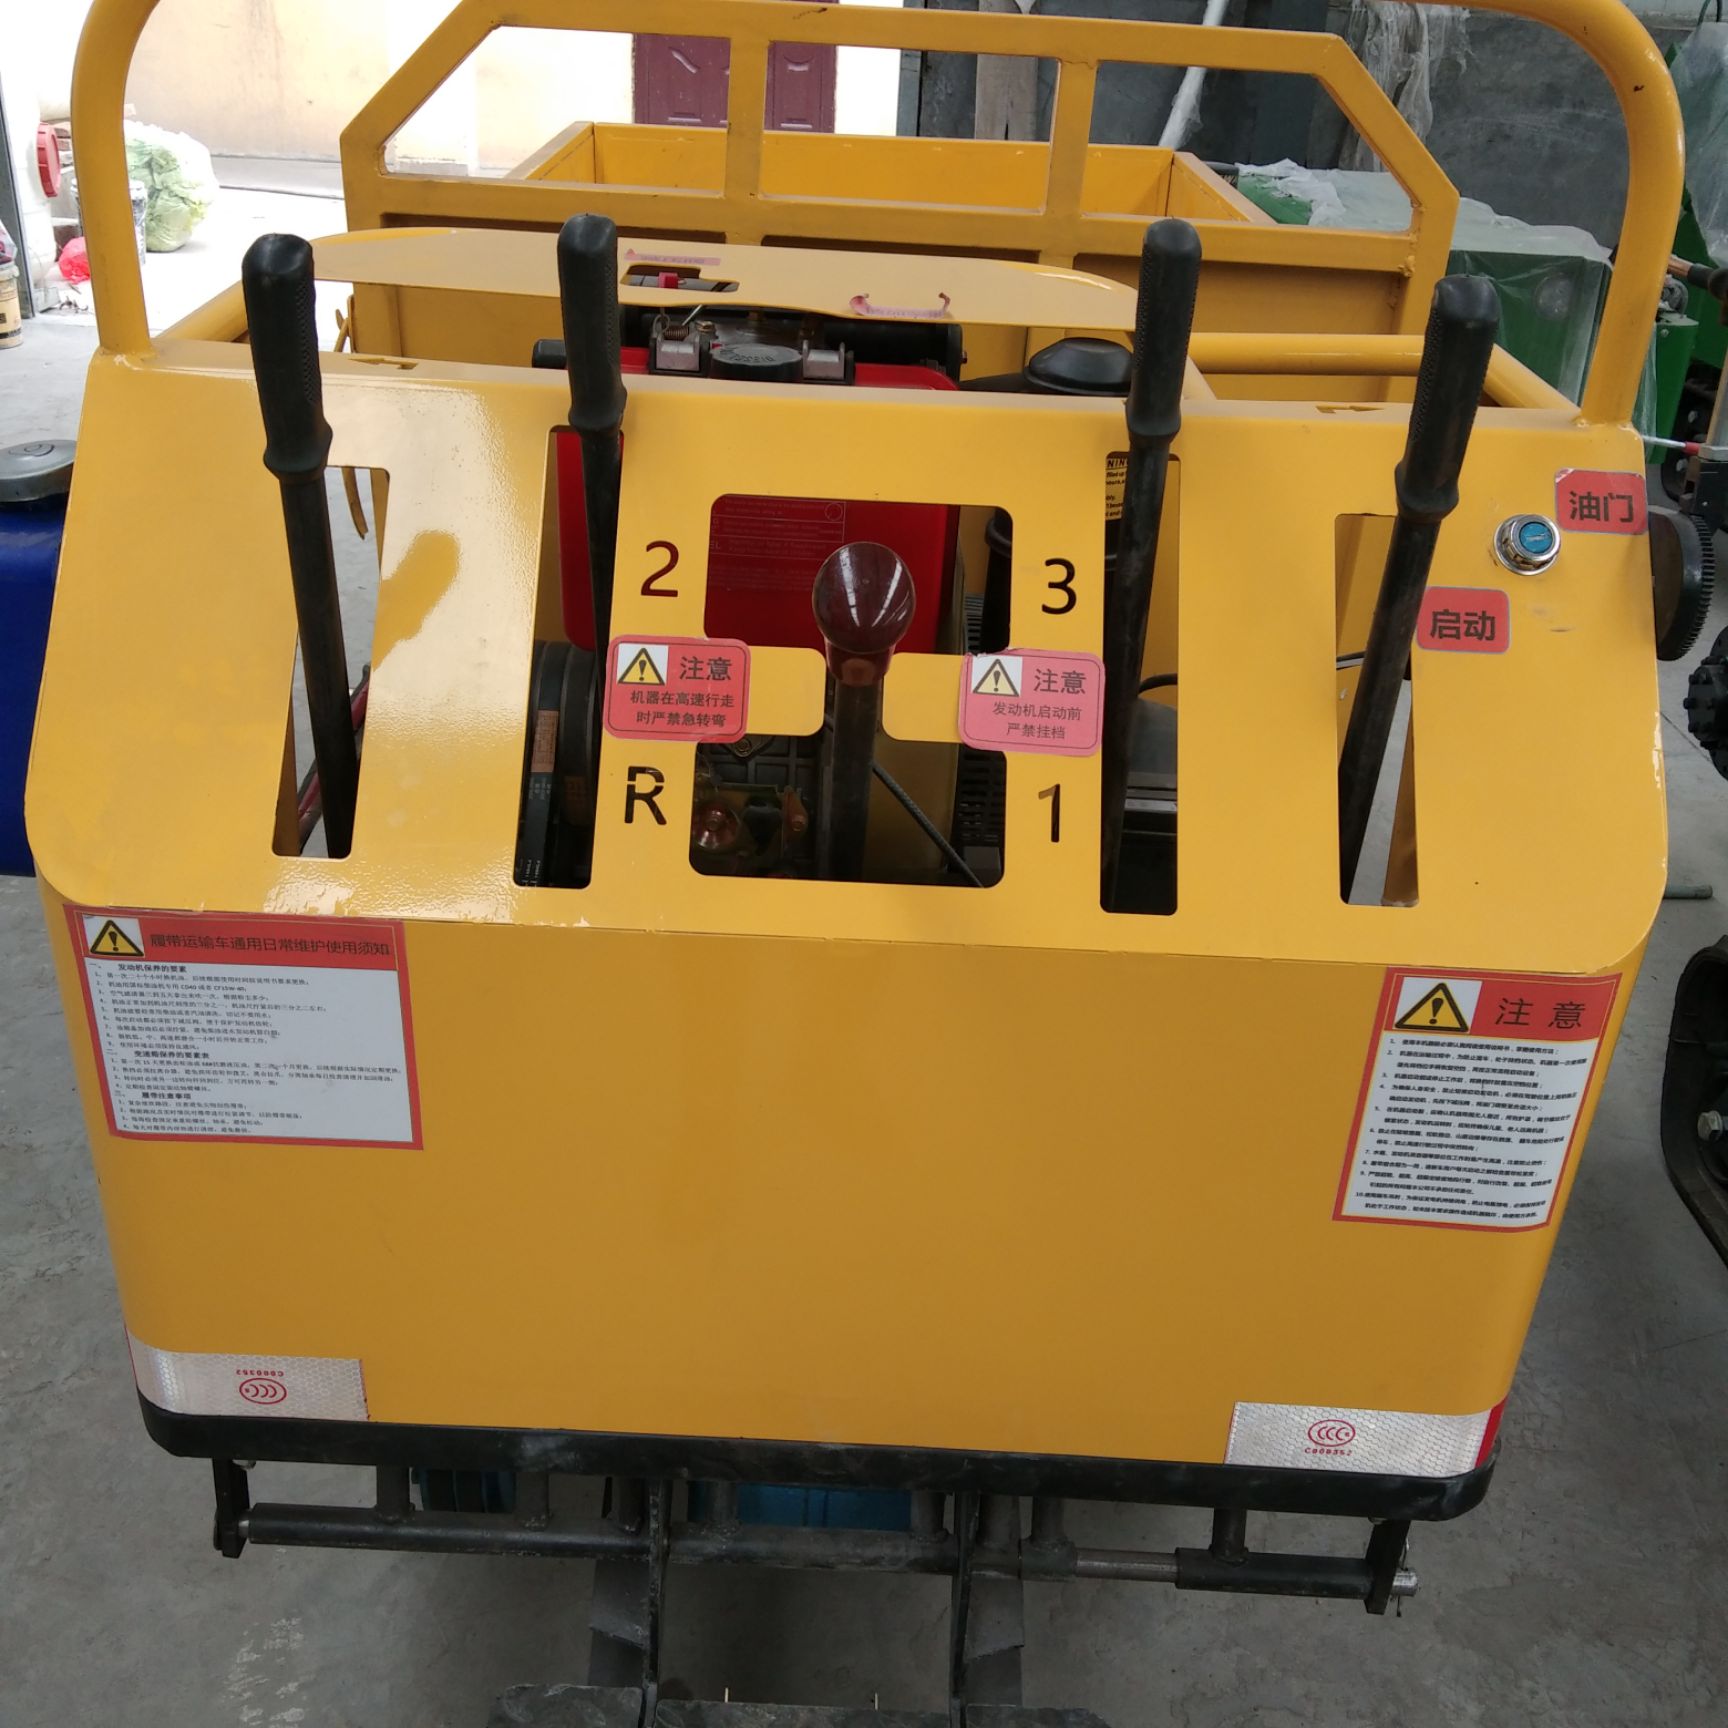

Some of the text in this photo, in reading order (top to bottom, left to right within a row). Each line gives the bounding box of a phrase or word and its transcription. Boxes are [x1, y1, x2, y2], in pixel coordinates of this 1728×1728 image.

[1569, 491, 1634, 523] 油门
[641, 540, 679, 597] 2
[1041, 557, 1077, 615] 3
[1430, 608, 1496, 641] 启动
[680, 656, 732, 681] 注意
[1033, 668, 1086, 694] 注意
[630, 690, 735, 708] 机器在高速行走
[992, 701, 1082, 721] 发动机启动前
[636, 711, 726, 727] 时严禁急转弯
[1006, 722, 1066, 739] 严禁挂档
[624, 765, 667, 825] R
[1038, 783, 1061, 843] 1
[151, 934, 390, 956] 履带运输车通用日常维护使用须知
